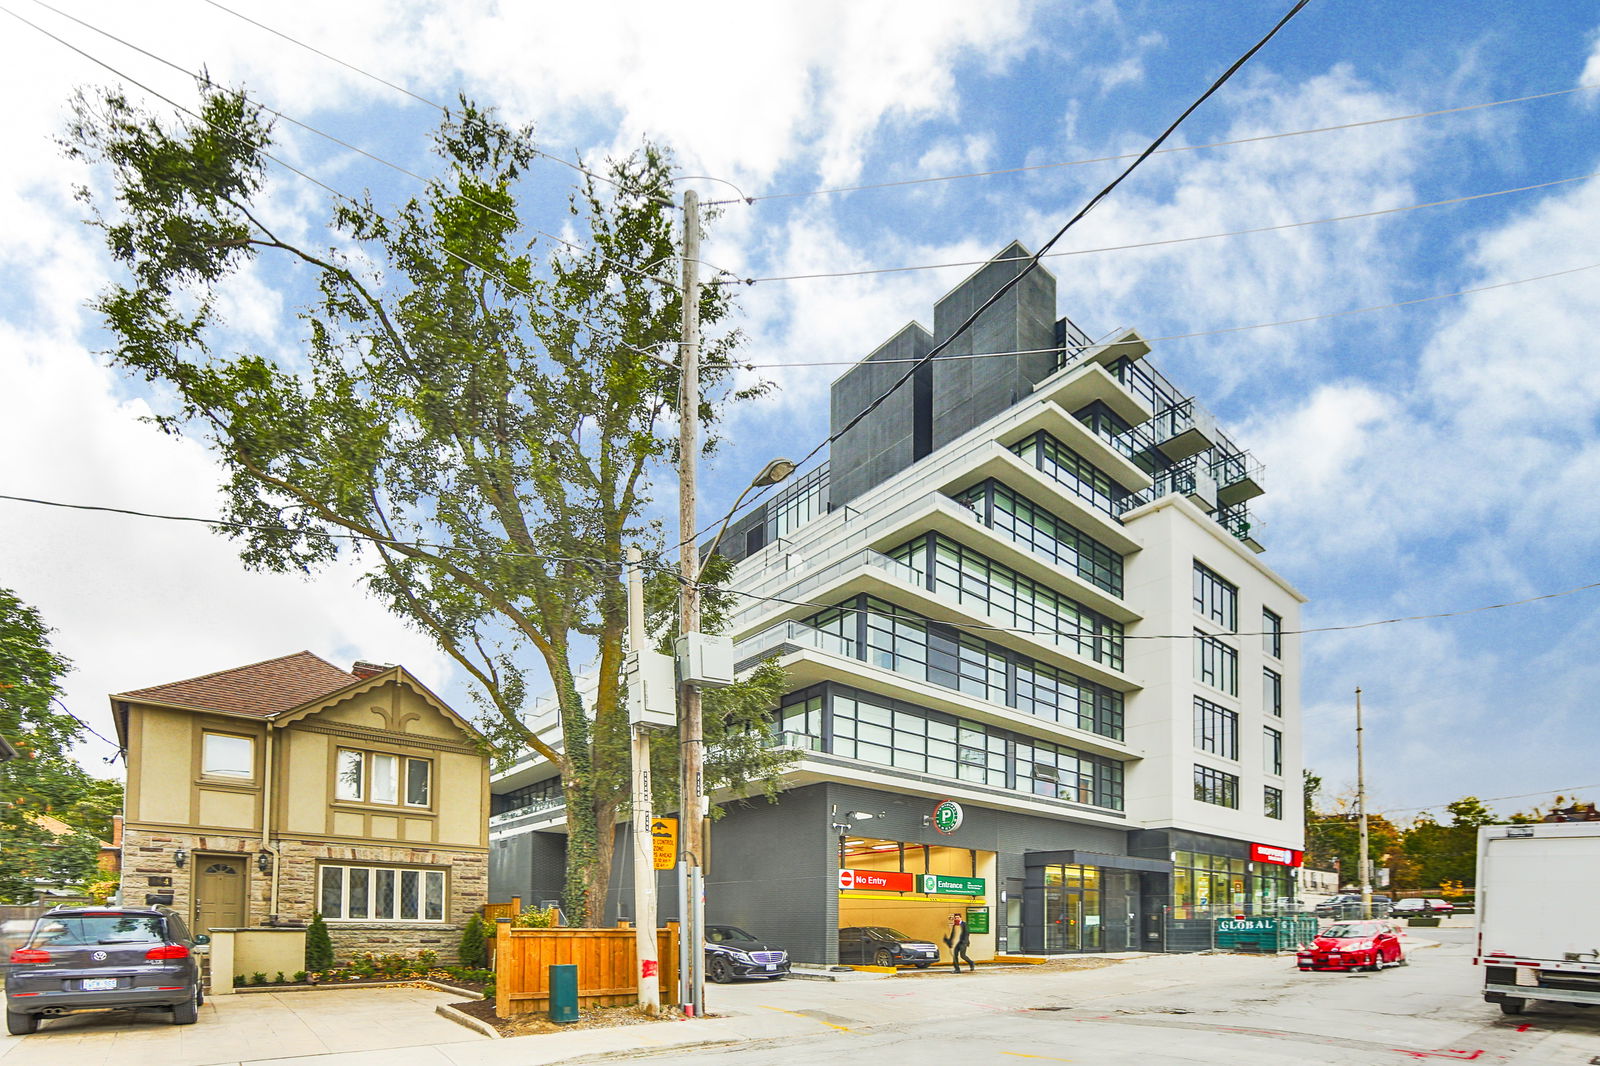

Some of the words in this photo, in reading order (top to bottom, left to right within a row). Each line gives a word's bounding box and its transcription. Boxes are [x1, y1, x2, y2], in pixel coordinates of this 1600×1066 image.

[942, 809, 952, 821] P
[856, 876, 867, 884] No
[868, 876, 887, 886] Entry
[938, 880, 963, 889] Entrance
[1221, 920, 1273, 930] GLOBAL
